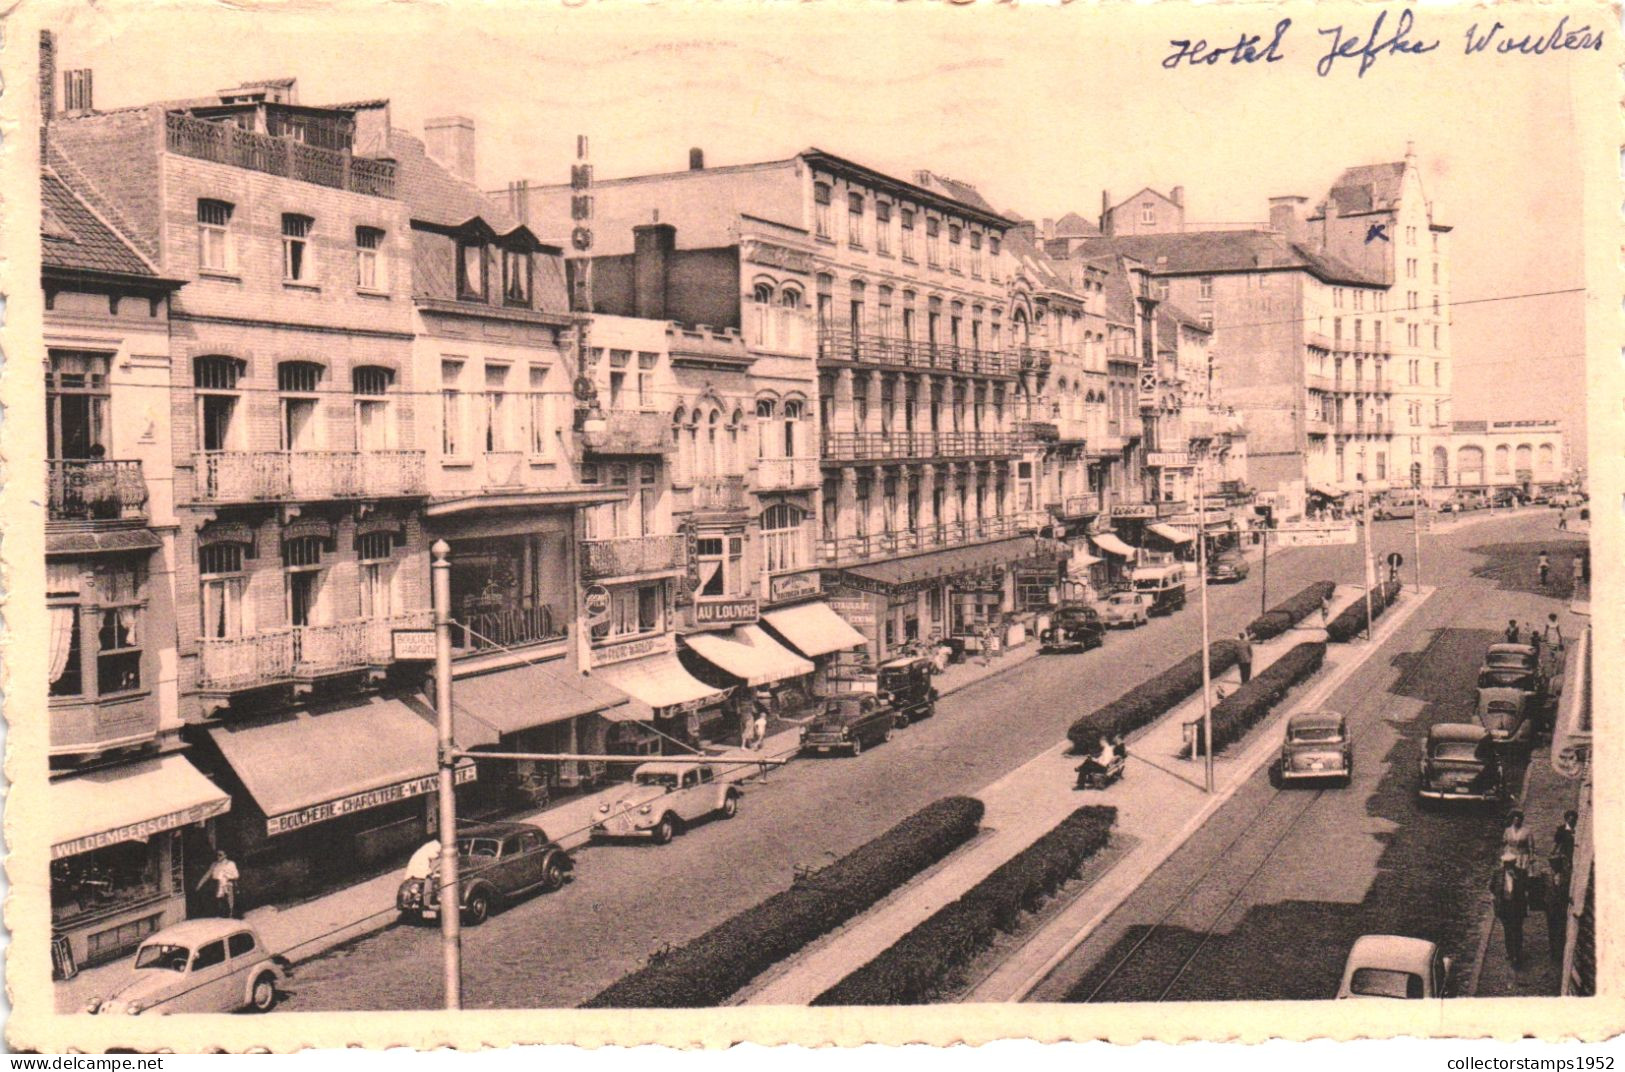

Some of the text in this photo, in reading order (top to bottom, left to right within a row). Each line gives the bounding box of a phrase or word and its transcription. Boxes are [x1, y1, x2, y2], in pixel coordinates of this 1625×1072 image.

[1162, 18, 1292, 69] Hotel
[687, 524, 697, 574] KODAK
[698, 604, 756, 619] AU LOUVRE
[56, 814, 177, 858] WILDEMEERSCH
[280, 803, 336, 830] BOUCHERIE
